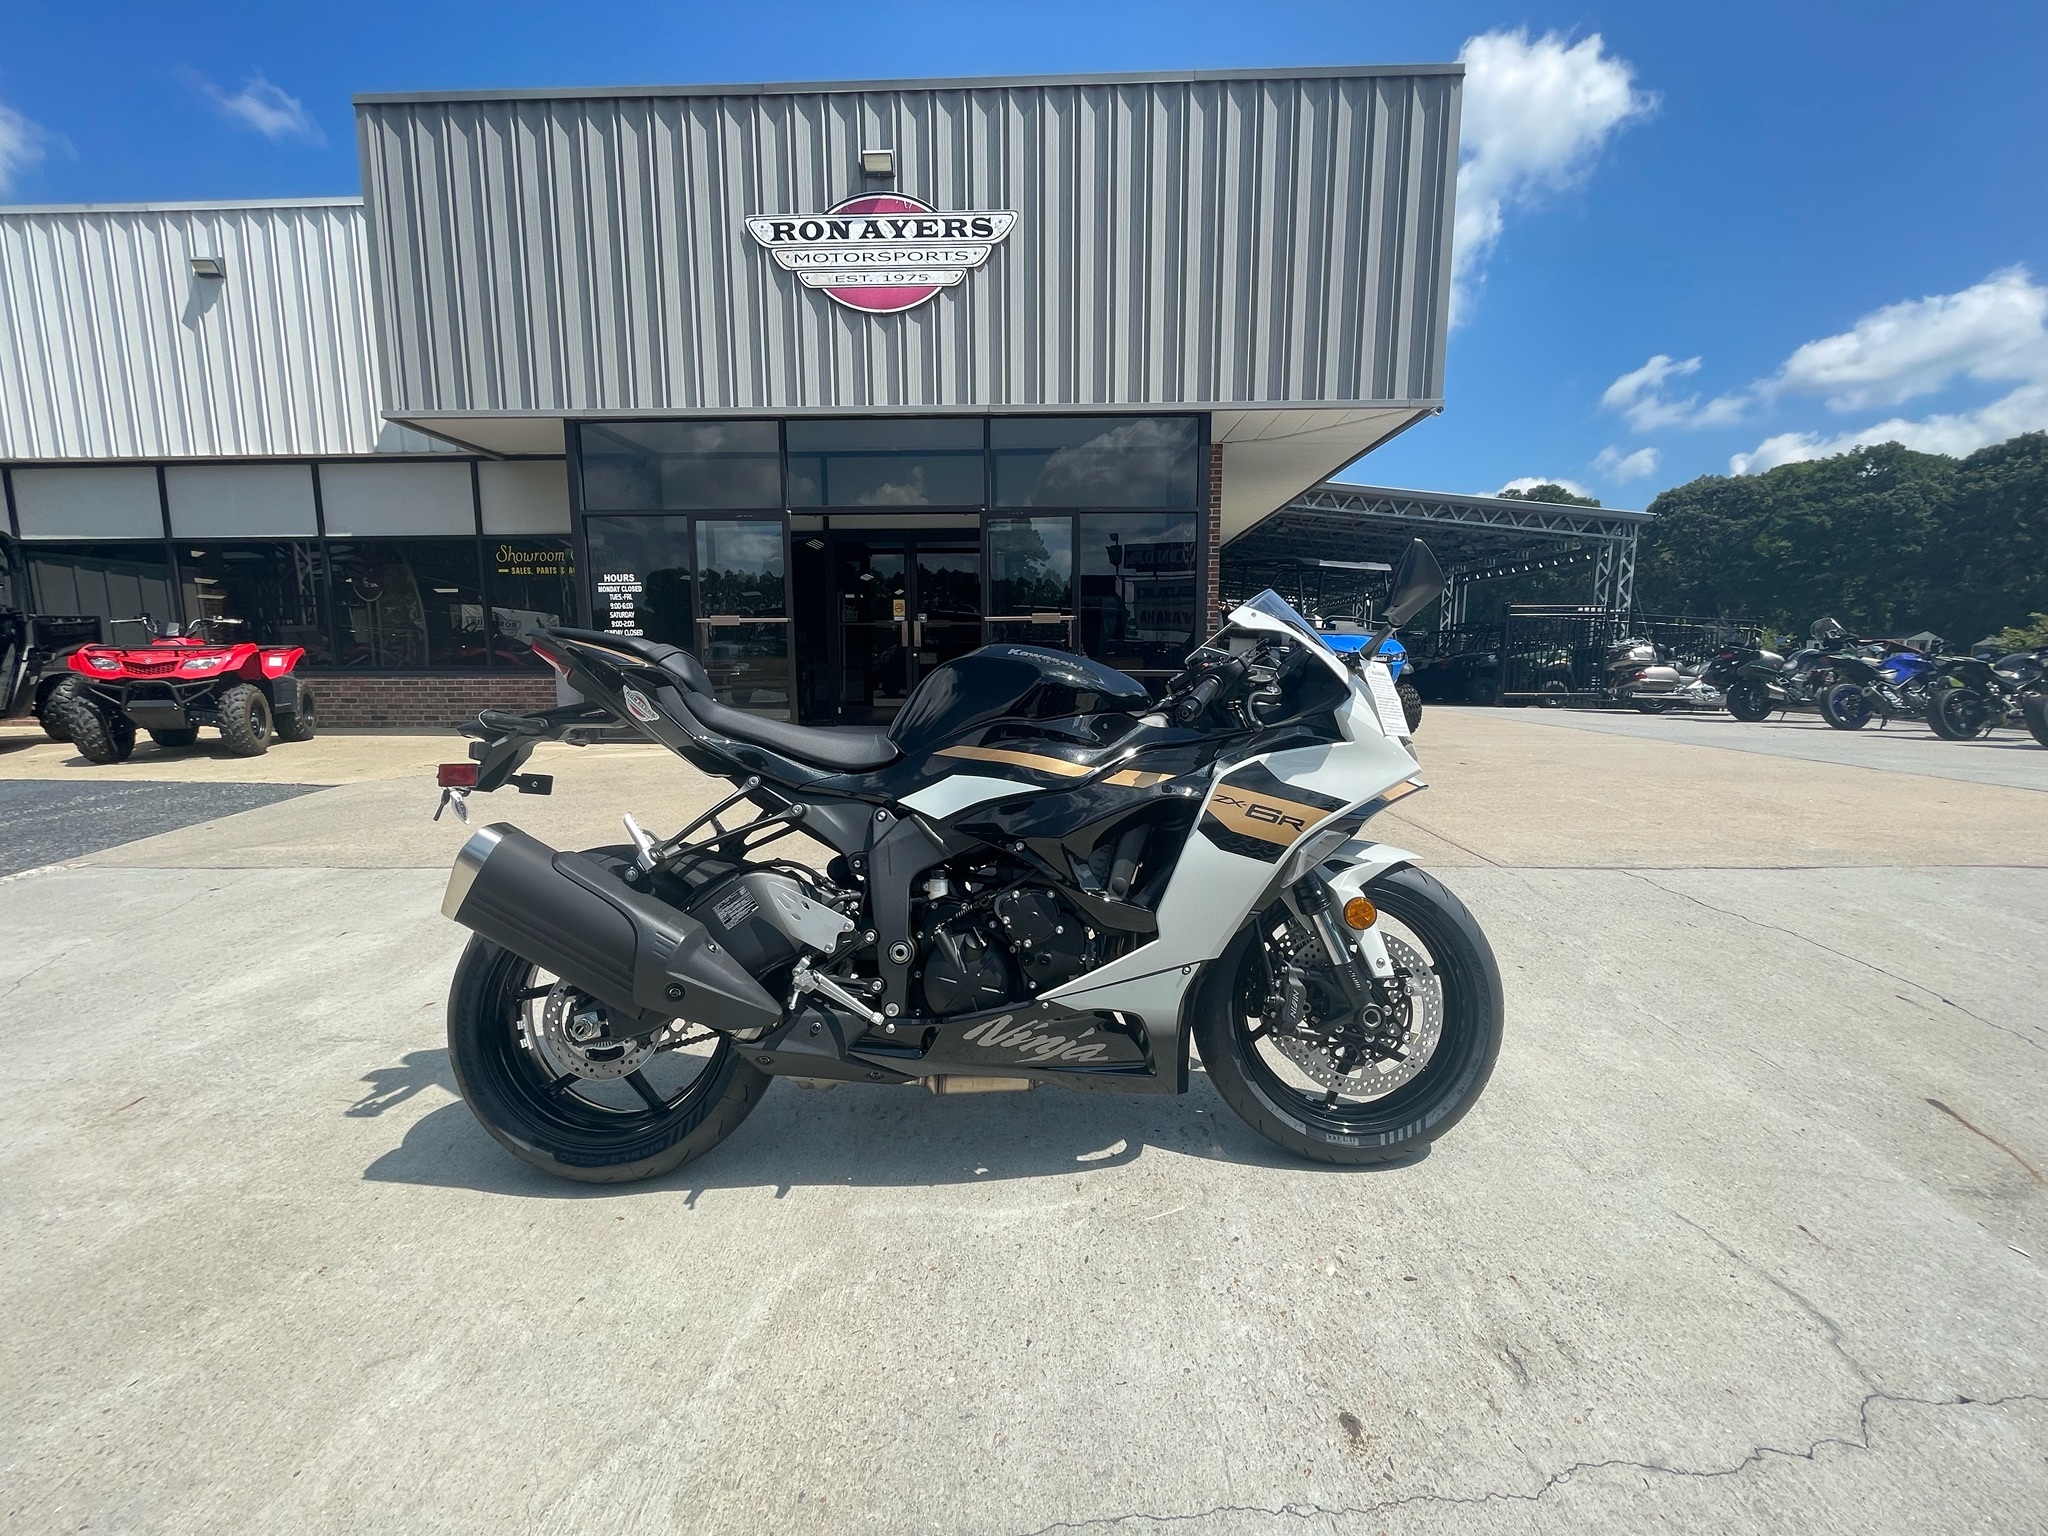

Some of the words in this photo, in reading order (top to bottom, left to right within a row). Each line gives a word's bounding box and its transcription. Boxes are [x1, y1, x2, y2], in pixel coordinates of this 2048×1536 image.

[770, 220, 853, 242] RON
[858, 217, 994, 240] AYERS
[793, 250, 969, 264] MOTORSPORTS
[835, 274, 873, 283] EST.
[884, 273, 930, 282] 1975
[496, 545, 565, 563] Showroom
[511, 567, 534, 575] SALES,
[603, 574, 635, 582] HOURS
[1007, 648, 1084, 671] Kawasaki
[962, 1014, 1109, 1063] Ninja
